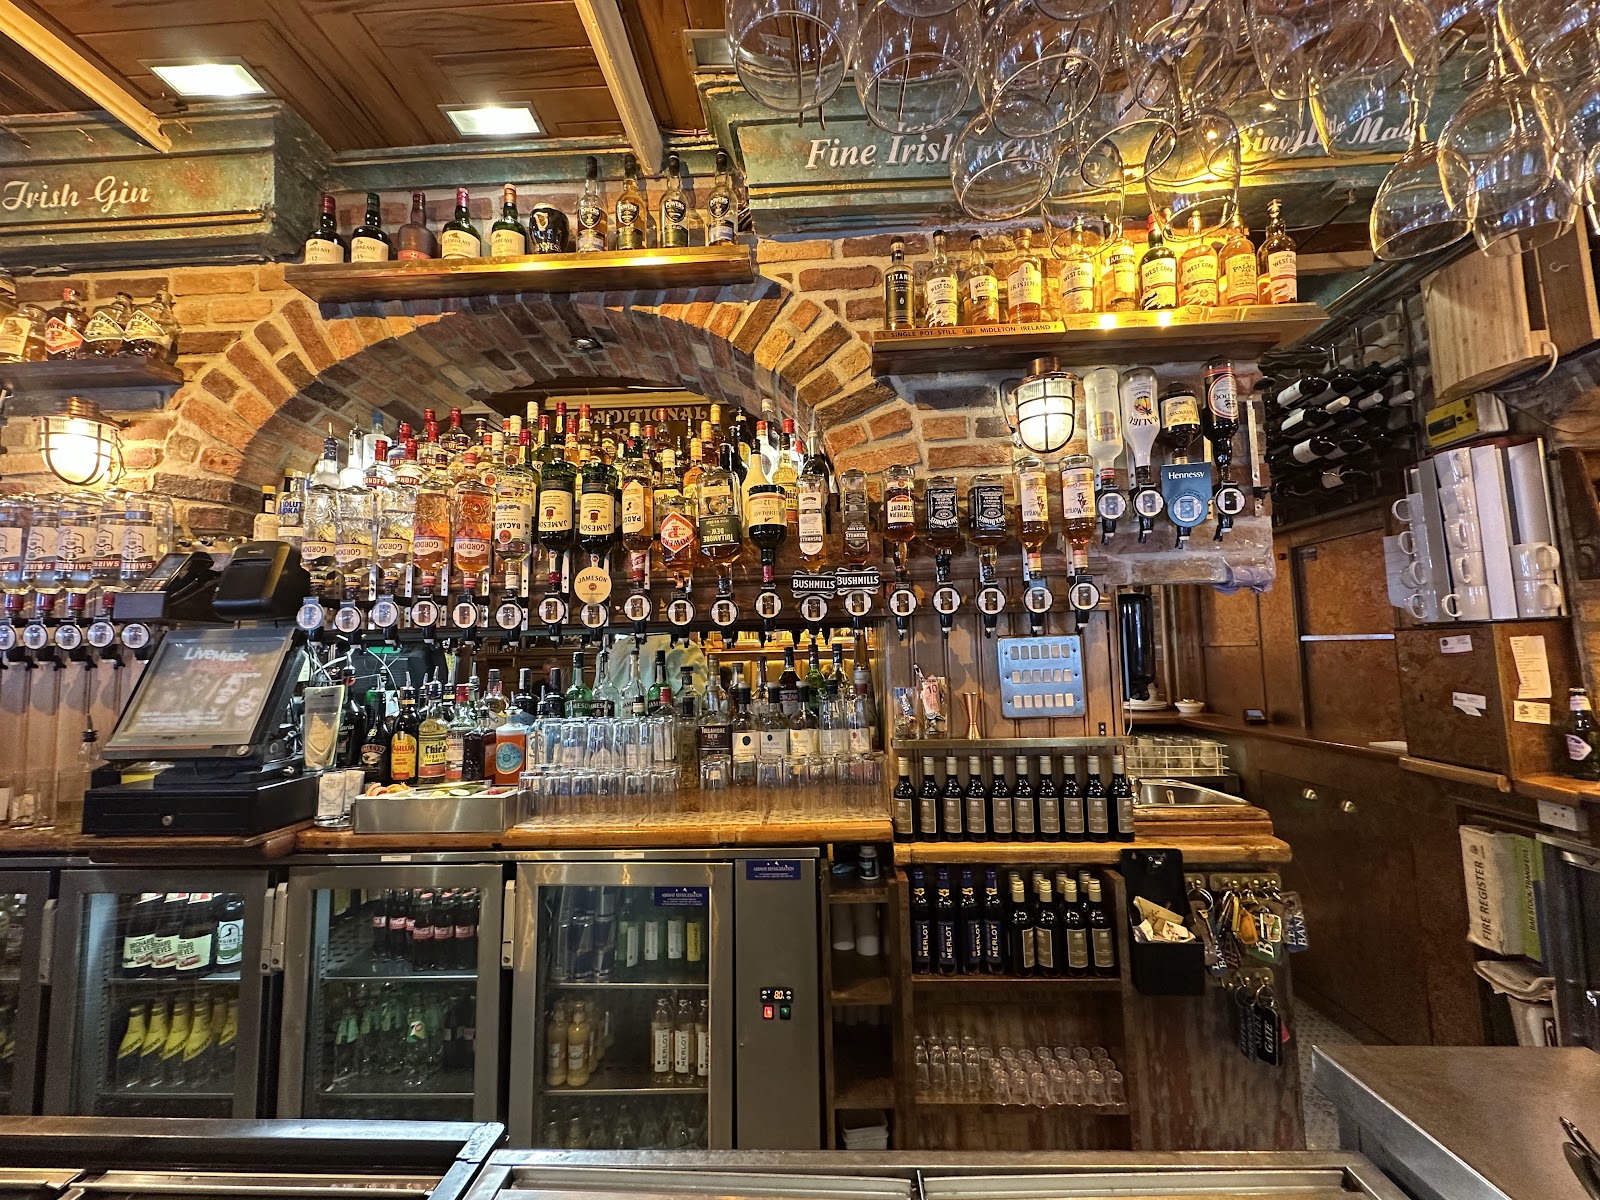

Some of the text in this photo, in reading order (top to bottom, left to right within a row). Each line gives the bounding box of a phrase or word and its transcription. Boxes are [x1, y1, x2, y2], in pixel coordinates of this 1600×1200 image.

[805, 139, 877, 170] Fine
[2, 176, 151, 213] Irish Gin
[1272, 258, 1288, 267] WEST
[1144, 267, 1159, 277] WEST
[1186, 264, 1200, 273] WEST
[887, 274, 914, 282] TITANIC
[1168, 471, 1205, 480] Hennessy
[668, 526, 679, 538] P
[703, 534, 734, 542] TULLAMORE
[577, 575, 607, 583] JAMESON
[793, 578, 835, 589] BUSHMILLS
[837, 575, 879, 585] BUSHMILLS
[927, 685, 938, 694] 10
[426, 745, 446, 754] Chica
[1474, 860, 1492, 942] FIRE REGISTER
[1294, 911, 1308, 946] BANK
[991, 924, 999, 958] MERLOT
[1265, 1020, 1273, 1054] GATE
